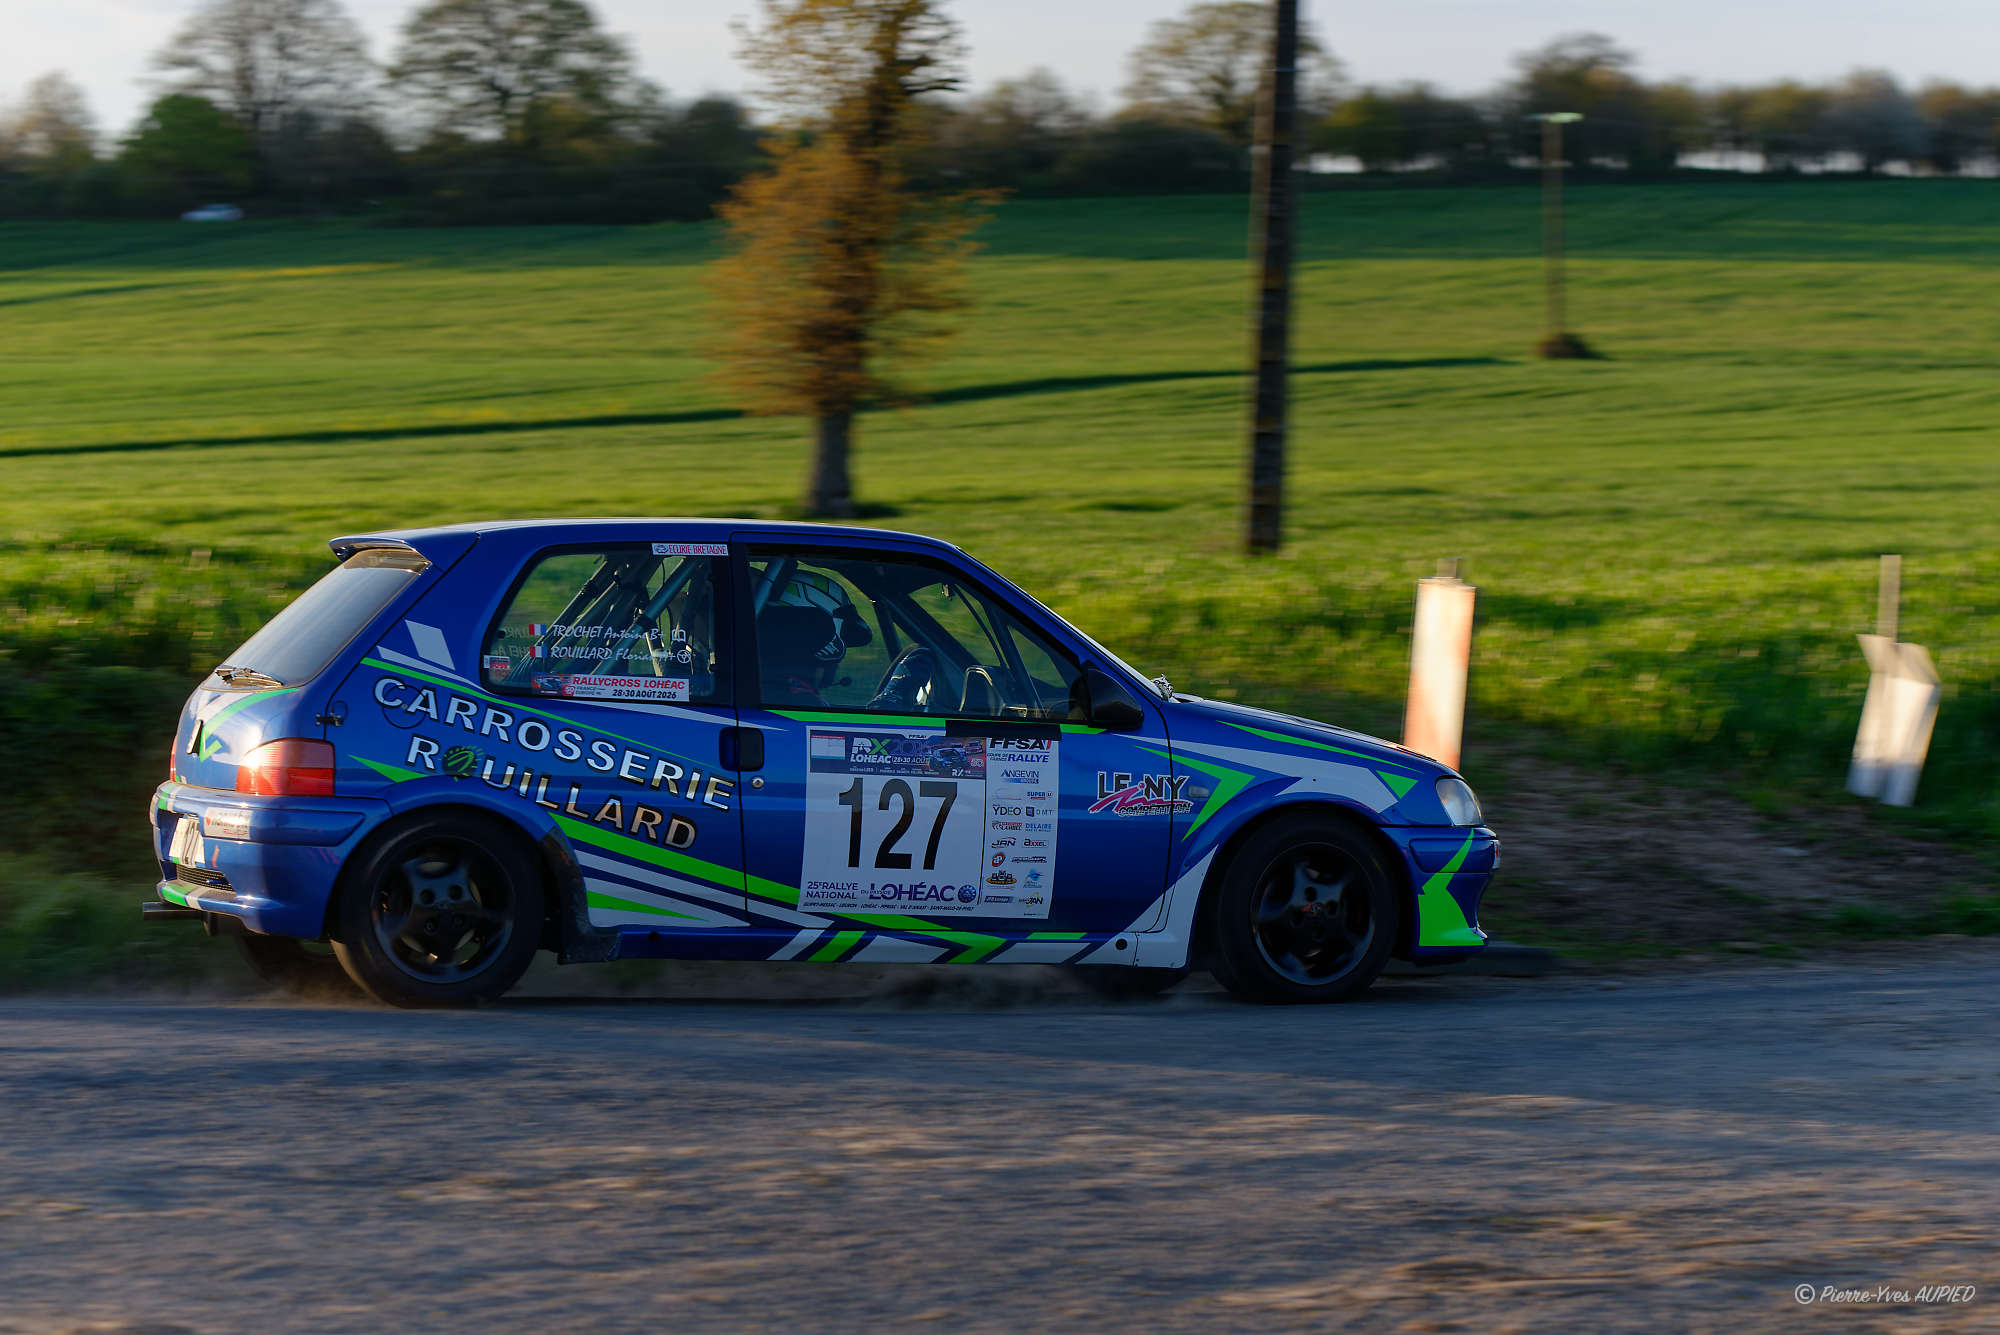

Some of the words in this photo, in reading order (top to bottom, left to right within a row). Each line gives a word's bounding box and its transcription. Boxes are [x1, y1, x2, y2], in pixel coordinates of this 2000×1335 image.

[551, 624, 603, 638] TROCHET
[550, 646, 613, 660] ROUILLARD
[572, 676, 641, 689] RALLYCROSS
[656, 690, 677, 700] 2026
[372, 676, 737, 812] CARROSSERIE
[1008, 753, 1050, 763] RALLYE
[1143, 773, 1190, 801] NY
[838, 775, 958, 871] 127
[806, 891, 857, 900] NATIONAL
[869, 881, 956, 902] LOHÉAC
